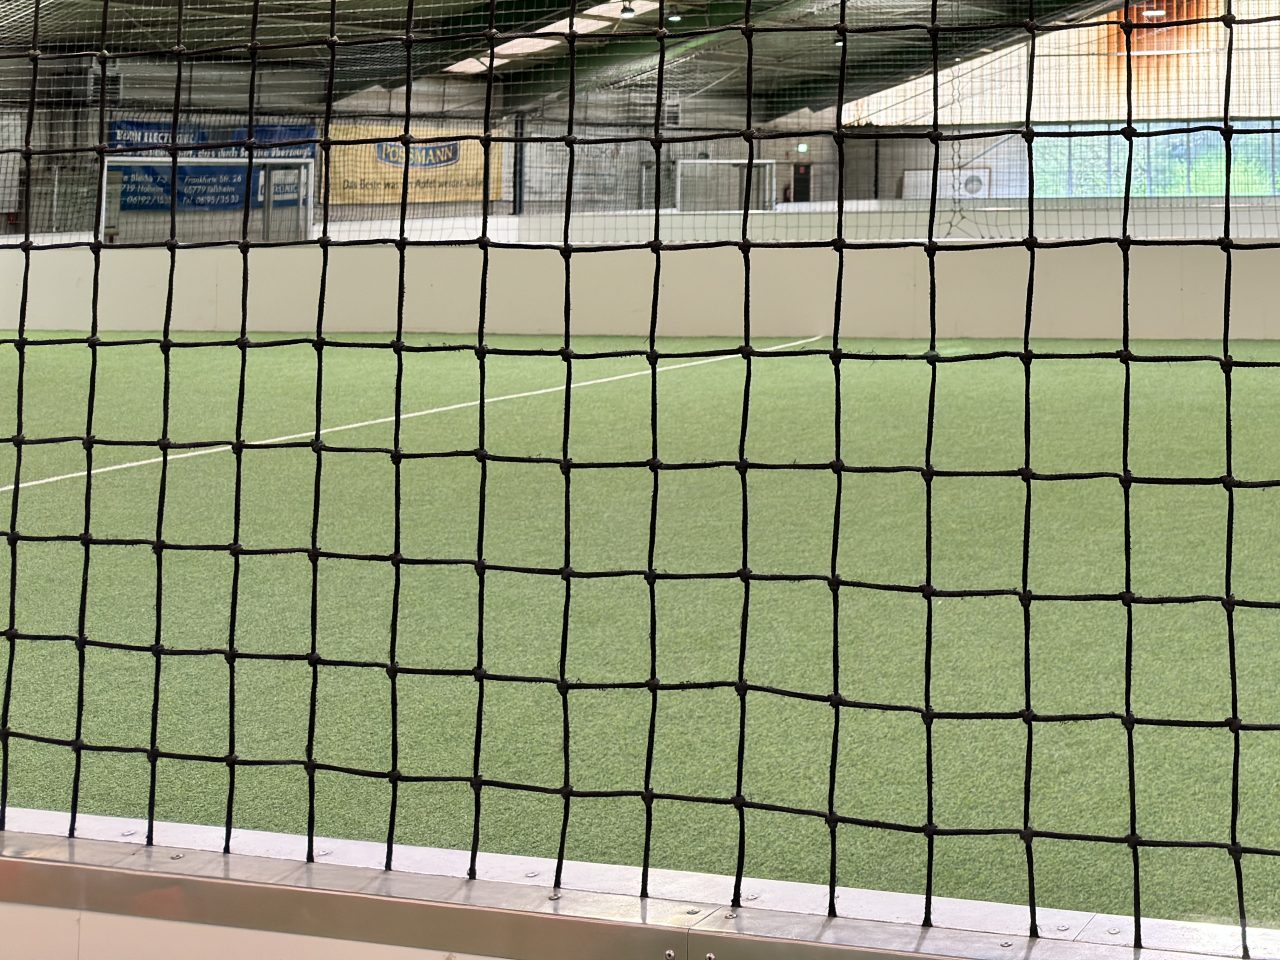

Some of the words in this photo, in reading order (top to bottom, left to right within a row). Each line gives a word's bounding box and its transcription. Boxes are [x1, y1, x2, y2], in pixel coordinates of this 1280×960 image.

[144, 132, 195, 143] ELECTONIC
[240, 147, 269, 158] Sevice
[382, 143, 453, 164] POSSMANN
